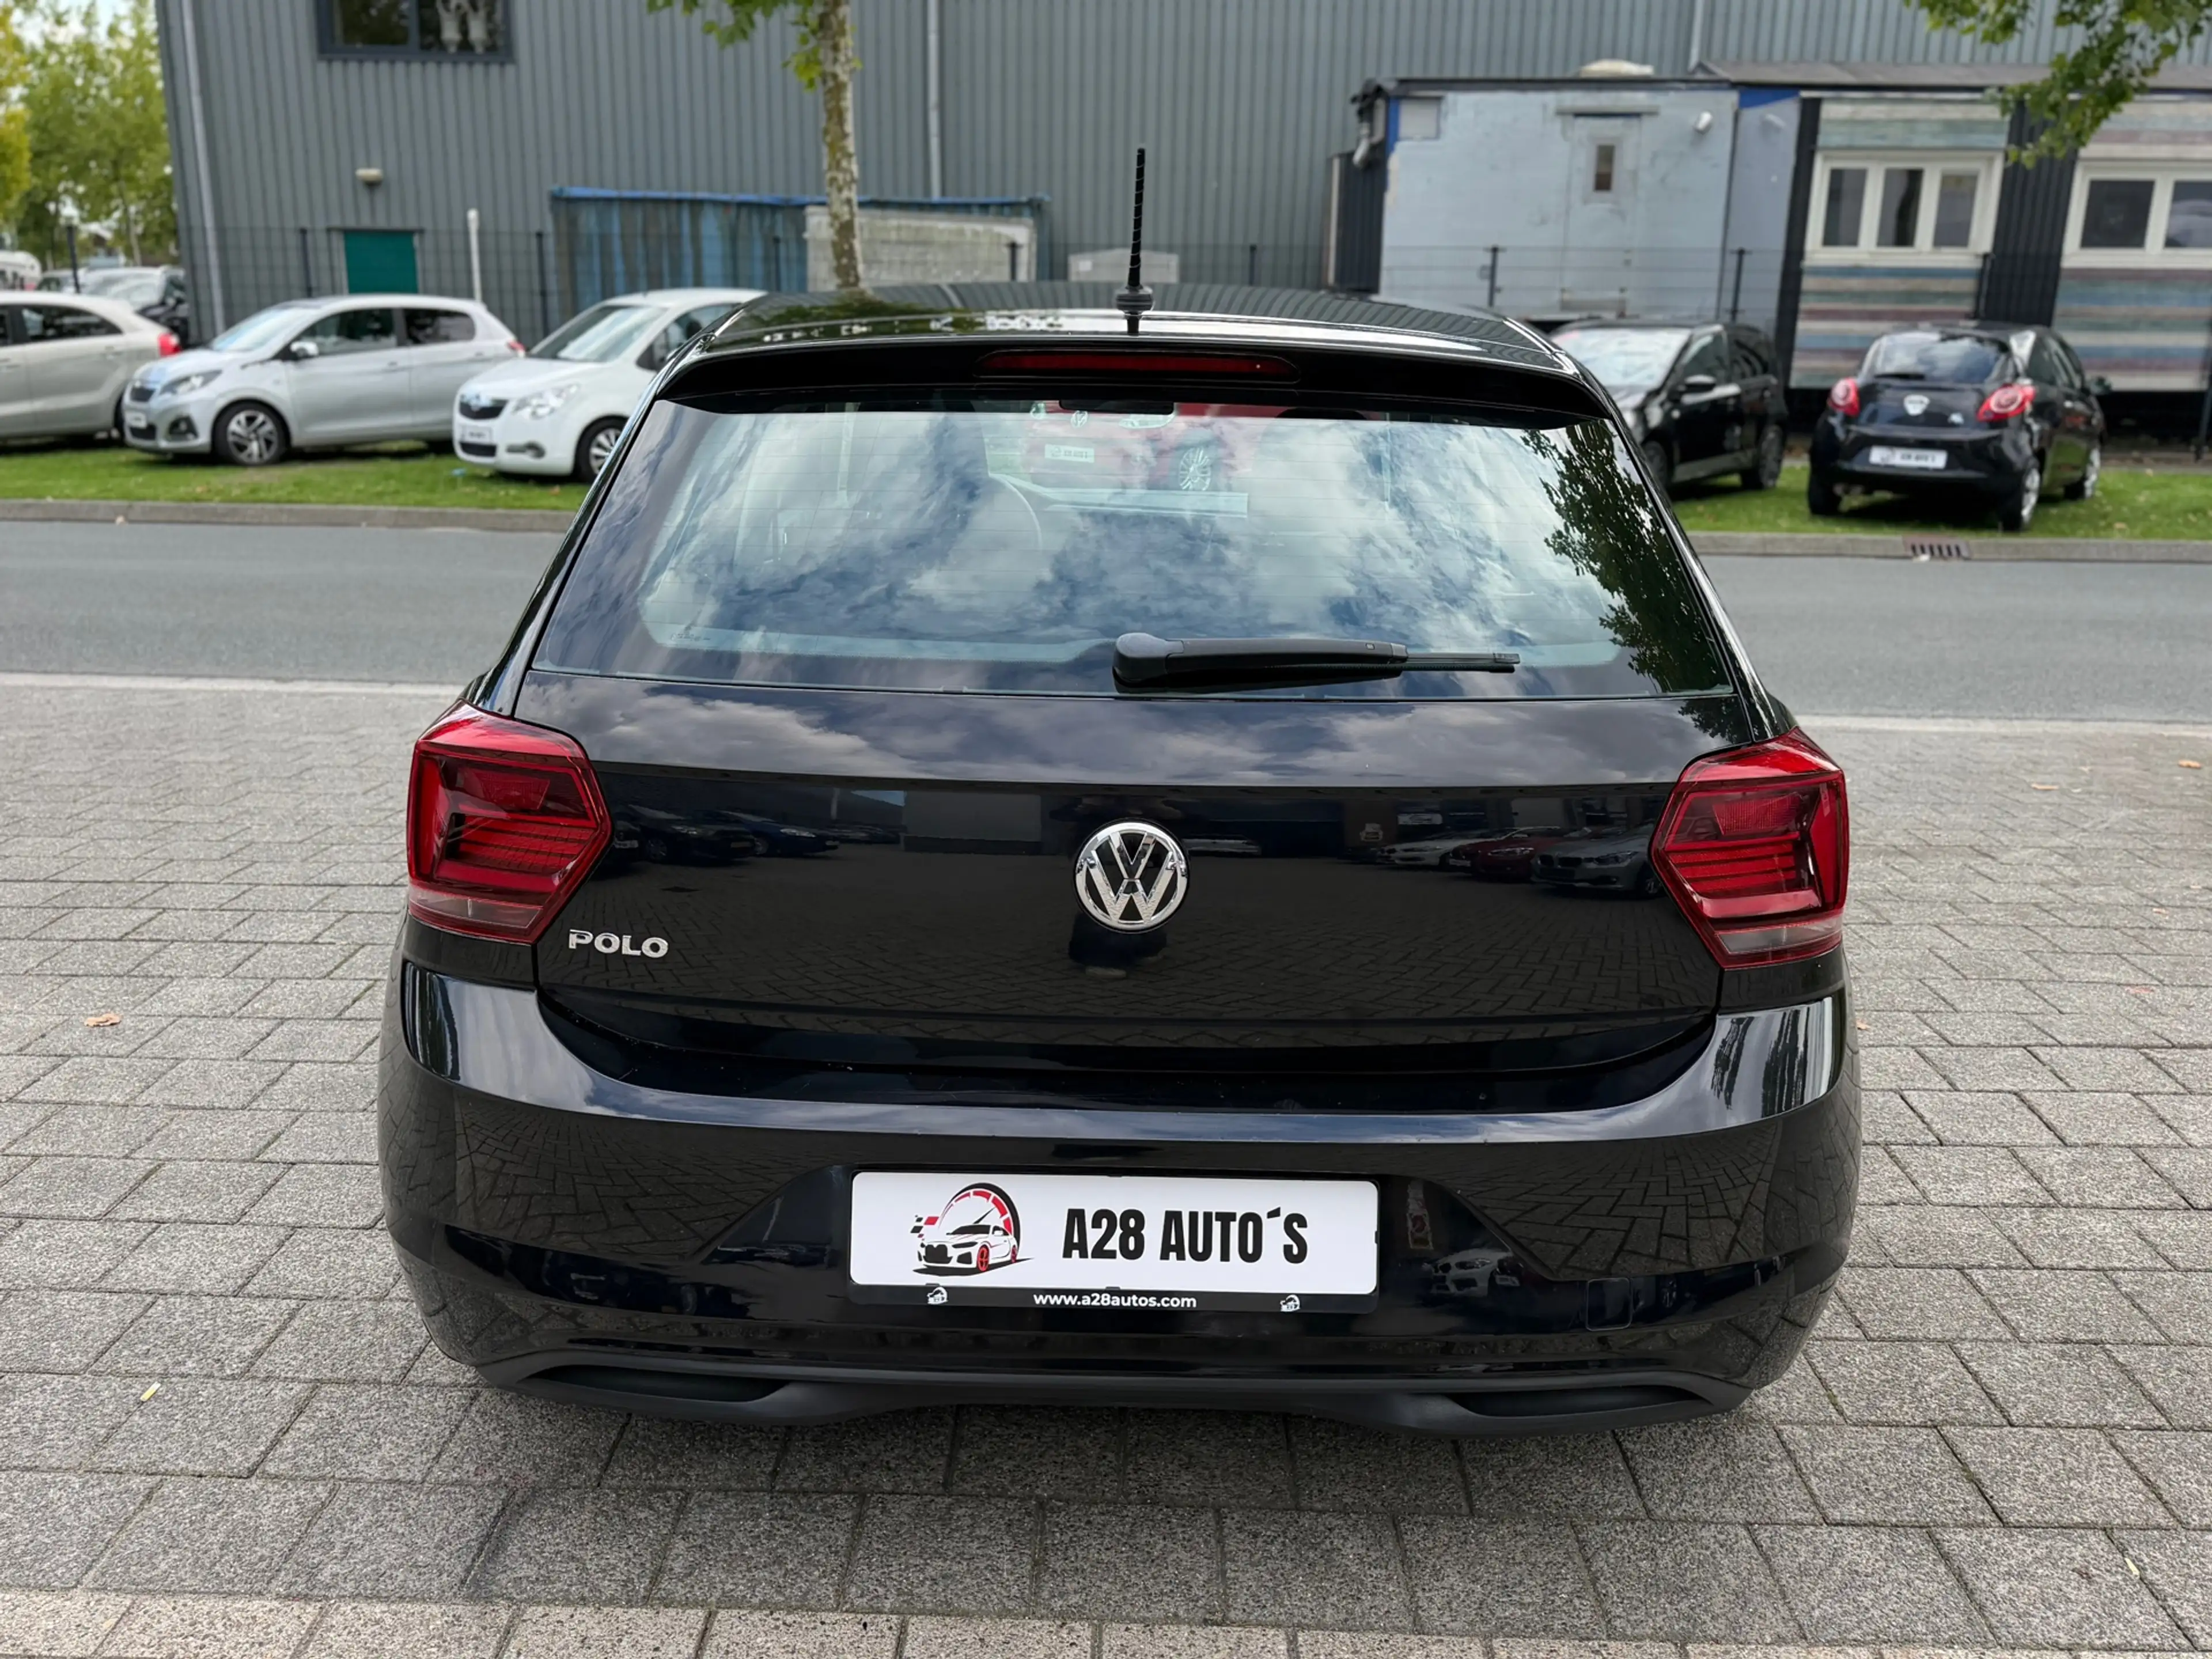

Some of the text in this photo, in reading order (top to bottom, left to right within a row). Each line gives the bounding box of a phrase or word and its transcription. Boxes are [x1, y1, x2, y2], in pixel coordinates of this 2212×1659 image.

[569, 929, 669, 958] POLO
[1062, 1208, 1145, 1260] A28
[1033, 1293, 1197, 1308] www.a28autos.com
